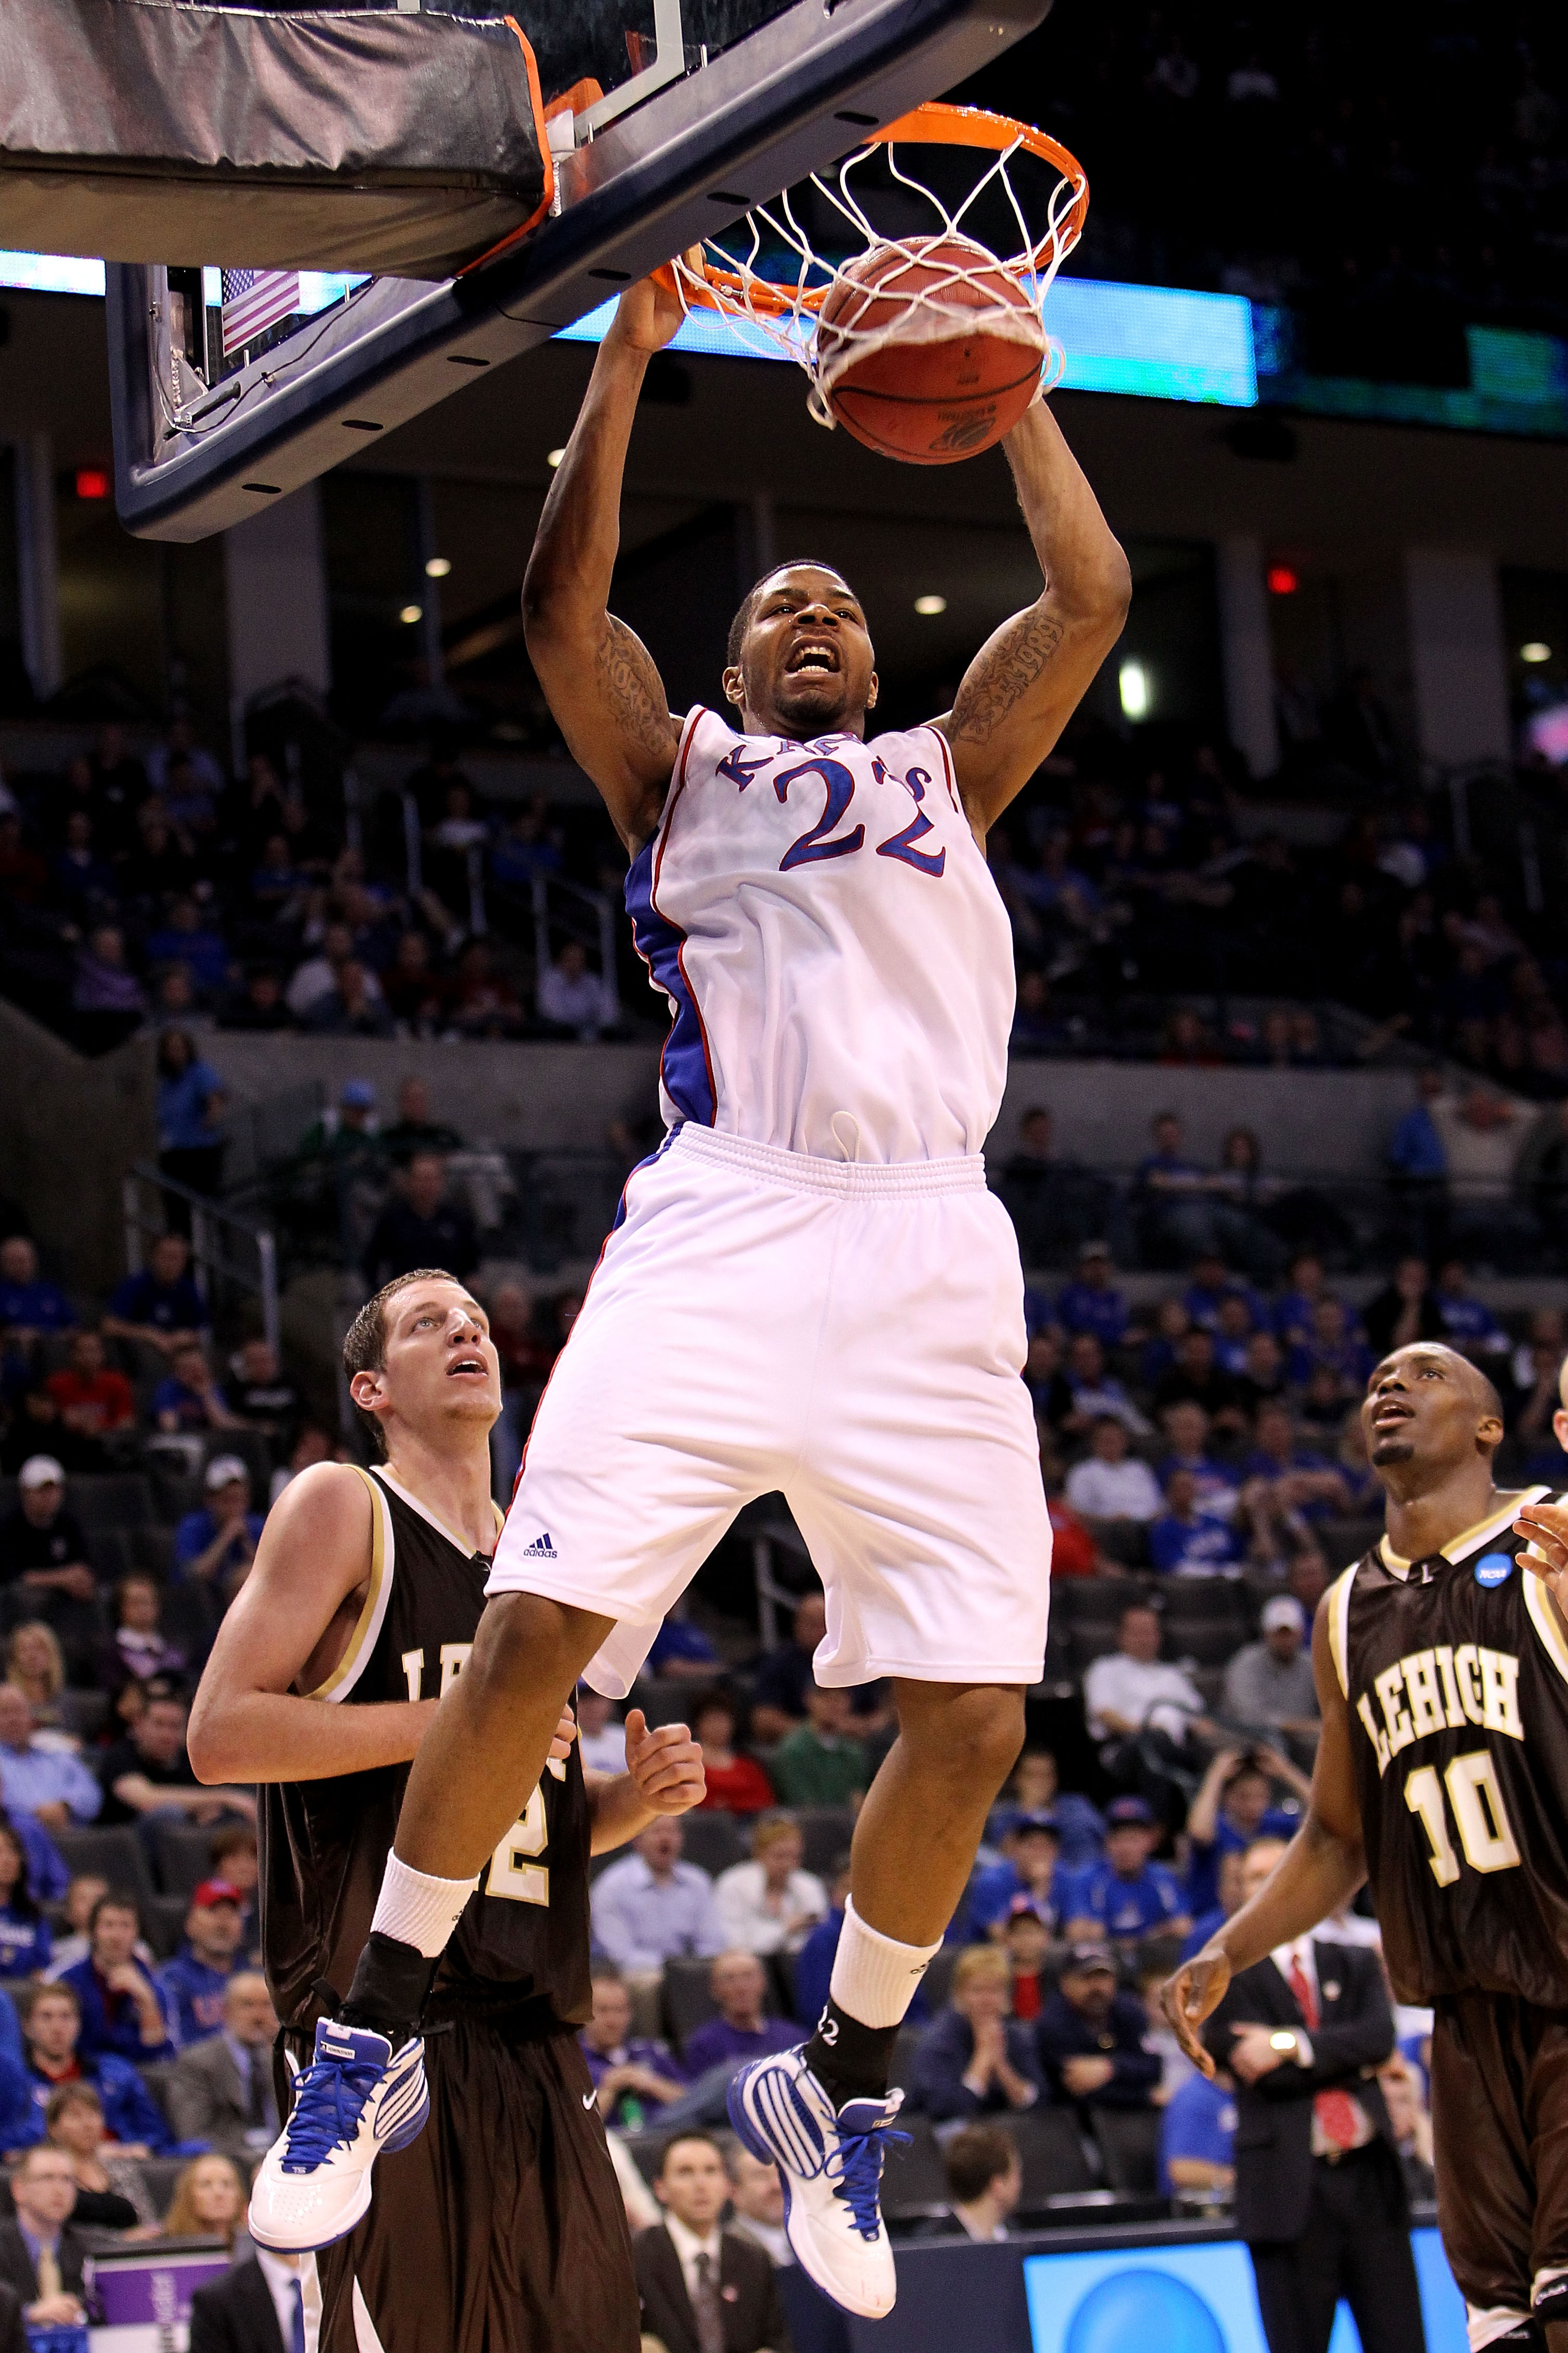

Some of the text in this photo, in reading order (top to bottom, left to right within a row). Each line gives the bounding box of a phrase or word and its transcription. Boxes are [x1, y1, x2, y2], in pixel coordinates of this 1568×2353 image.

[773, 757, 946, 878] 22
[524, 1547, 557, 1559] adidas
[1356, 1643, 1525, 1778] LEHIGH
[475, 1782, 550, 1908] 2
[1404, 1749, 1522, 1888] 10
